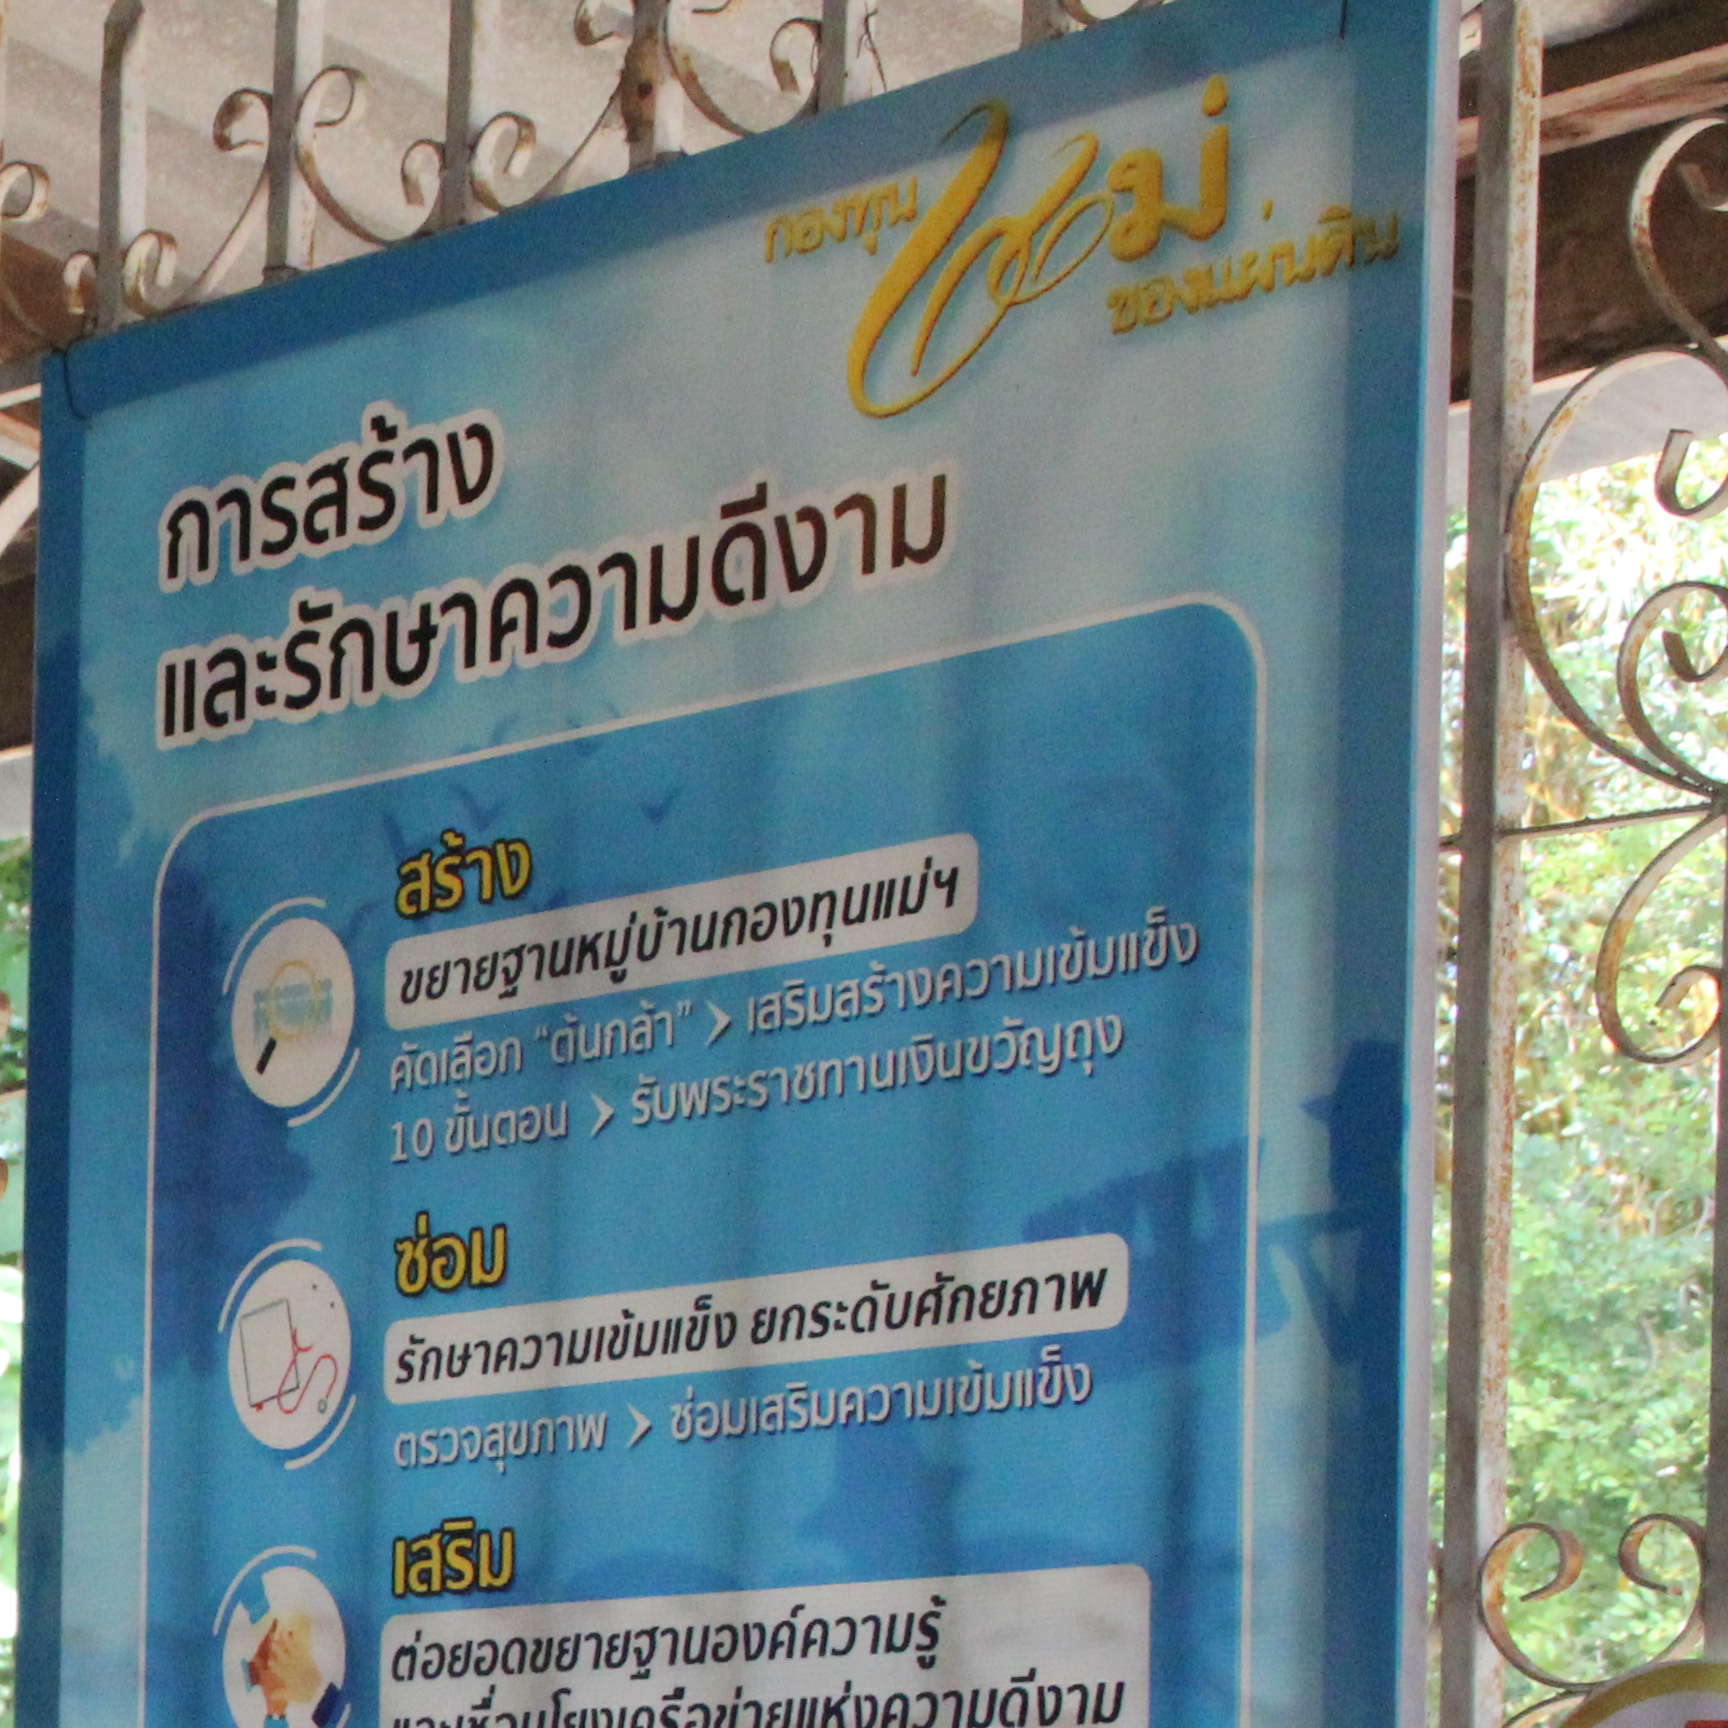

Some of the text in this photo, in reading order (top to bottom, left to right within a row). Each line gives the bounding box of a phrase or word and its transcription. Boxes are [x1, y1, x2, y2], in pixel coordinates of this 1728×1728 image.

[166, 413, 496, 577] การสร้าง
[163, 472, 947, 735] และรักษาความดีงาม
[395, 831, 530, 919] สร้าง
[401, 860, 957, 1003] ขยายฐานหมู่บ้านกองทุนแม่ฯ
[389, 1016, 522, 1094] คัดเลือก
[747, 906, 1199, 1035] เสริมสร้างความเข้มแข็ง
[389, 1011, 1123, 1162] 10 ขั้นตอน รับพระราชทานเงินขวัญถุง
[395, 1211, 506, 1296] ซ่อม
[397, 1263, 1107, 1384] รักษาความเข้มแข็ง ยกระดับศักยภาพ
[392, 1359, 1091, 1472] ตรวจสุขภาพ ซ่อมเสริมความเข้มแข็ง
[391, 1517, 512, 1596] เสริม
[391, 1596, 945, 1685] ต่อยอดขยายฐานองค์ความรู้
